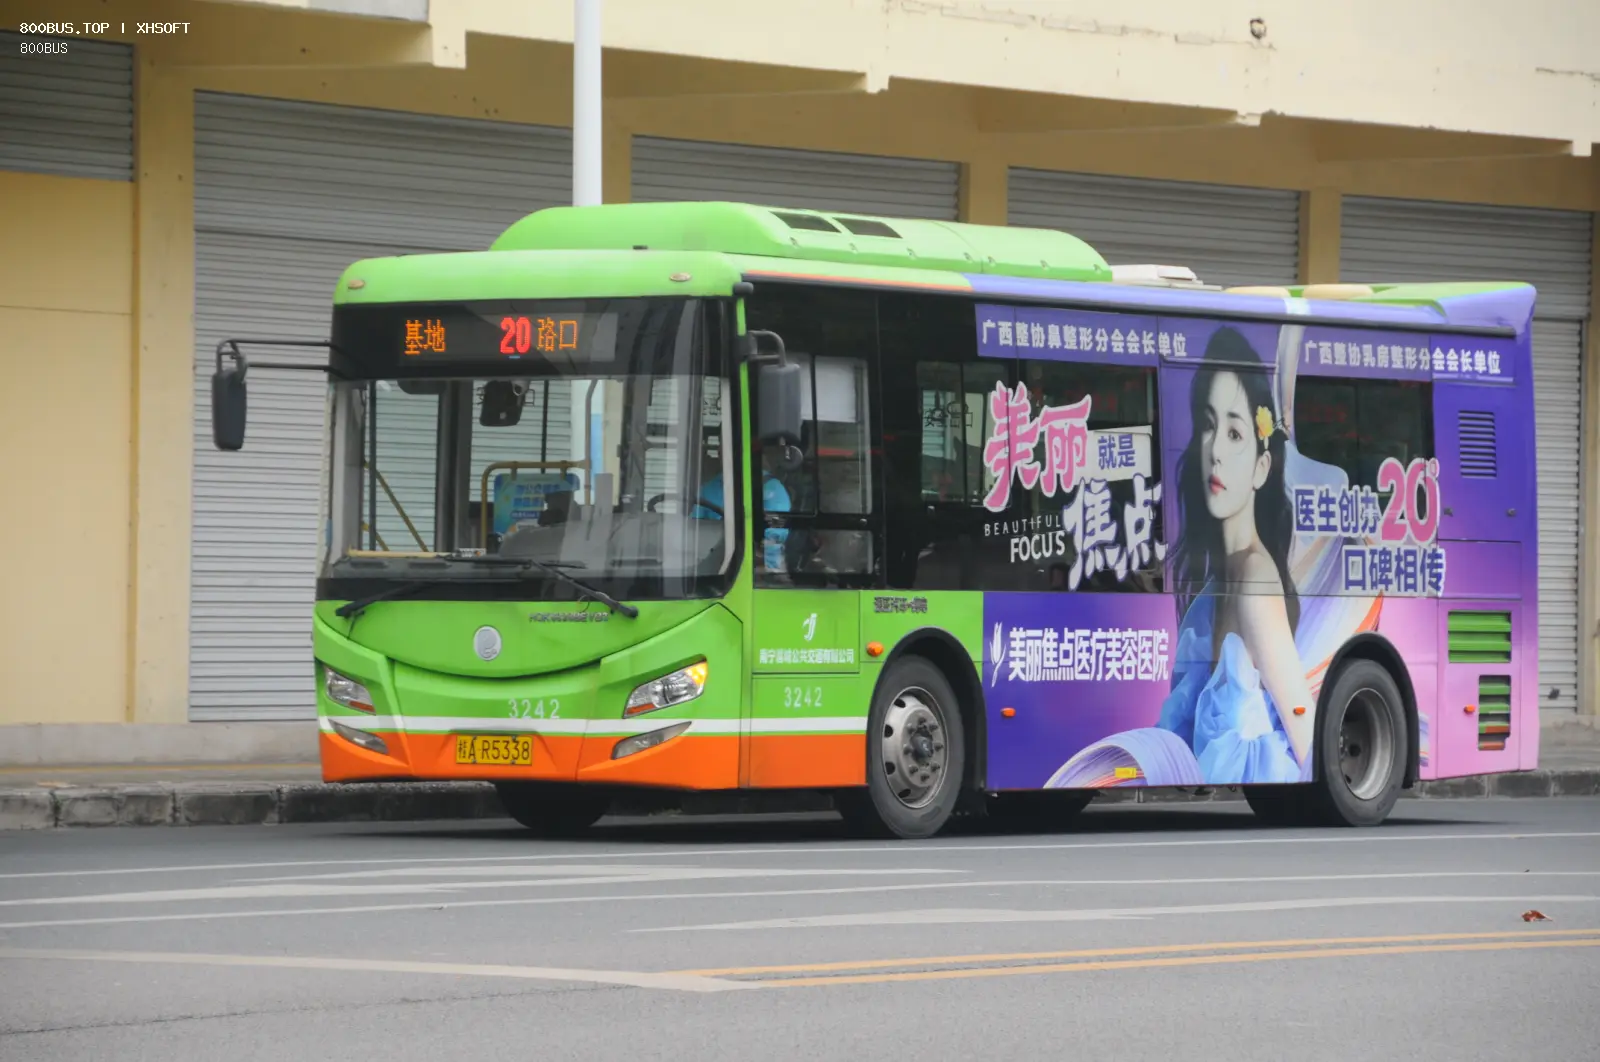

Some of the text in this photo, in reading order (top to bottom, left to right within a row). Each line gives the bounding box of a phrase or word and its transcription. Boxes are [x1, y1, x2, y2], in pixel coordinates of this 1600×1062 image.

[404, 316, 578, 355] 基地 20 路口
[982, 319, 1188, 357] 广西整协鼻整形分会会长单位
[1304, 339, 1501, 374] 广西整协乳房整形分会会长单位
[983, 379, 1093, 512] 美丽
[1097, 434, 1136, 470] 就是
[984, 515, 1061, 537] BEAUTIFUL
[1063, 473, 1169, 592] 焦点
[1009, 530, 1066, 563] FOCUS
[1343, 546, 1446, 595] 口碑相传
[1008, 626, 1169, 682] 美丽焦点医疗美容医院
[508, 698, 560, 719] 3242
[784, 687, 822, 708] 3242
